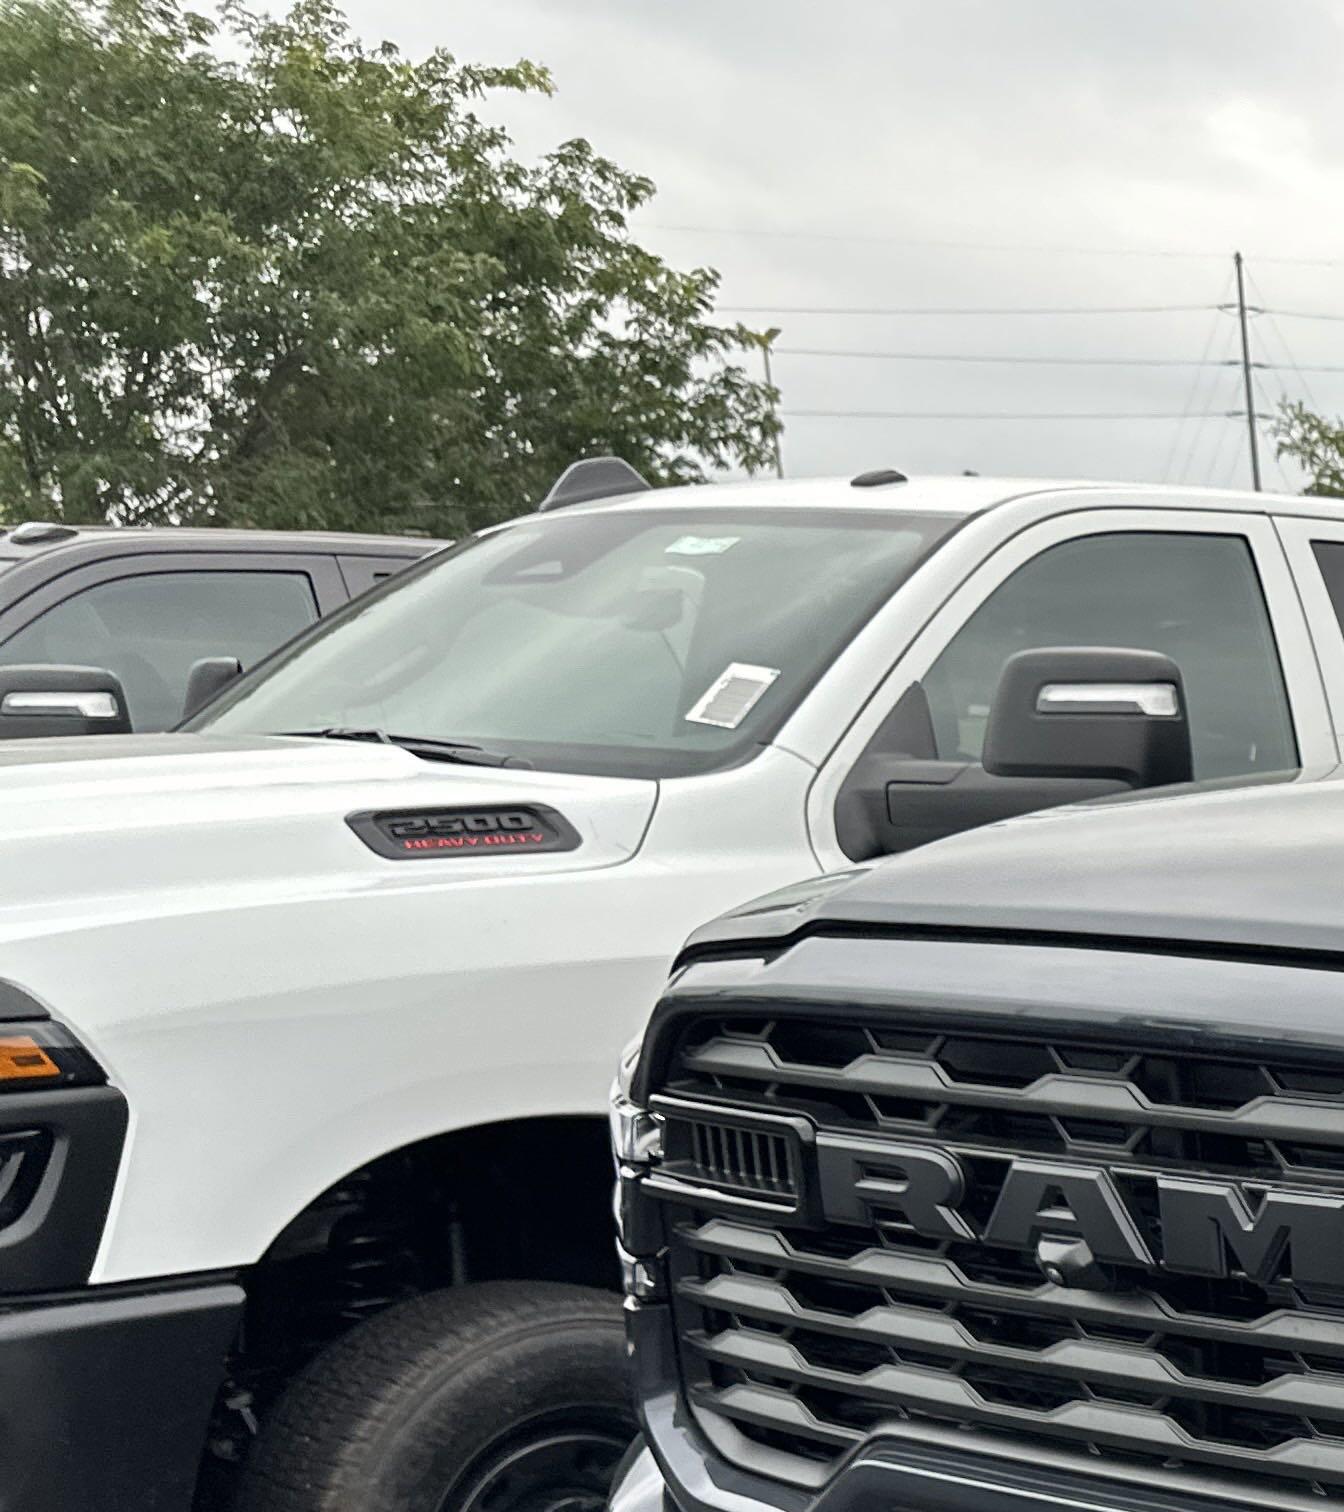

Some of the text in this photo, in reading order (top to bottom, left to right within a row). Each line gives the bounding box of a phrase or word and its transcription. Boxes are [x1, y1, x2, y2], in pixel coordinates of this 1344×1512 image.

[388, 811, 535, 838] 2500
[404, 833, 544, 849] HEAVY DUTY
